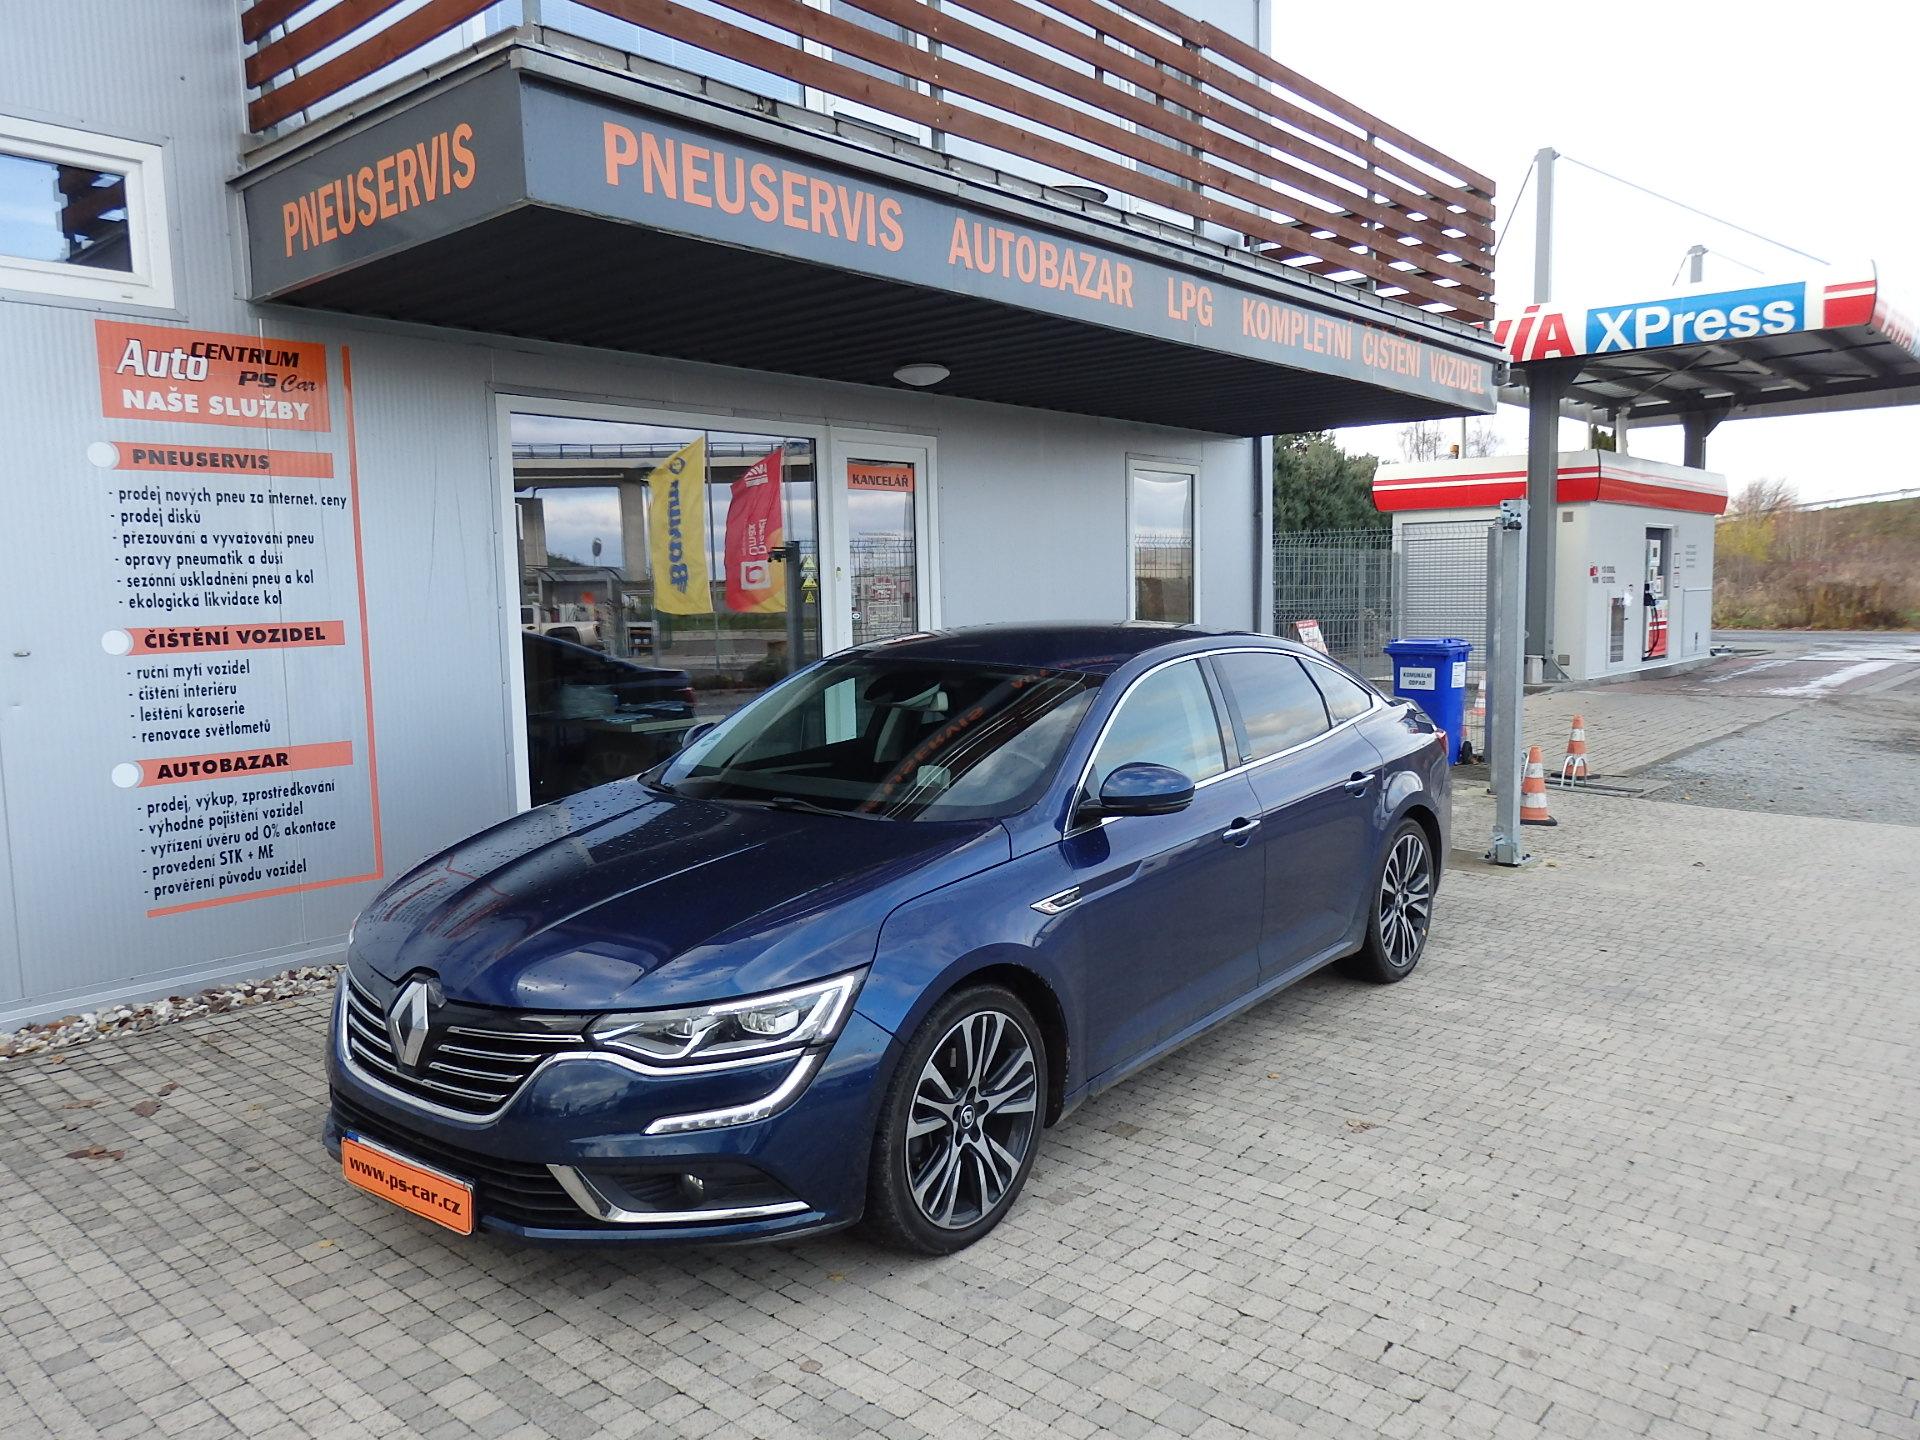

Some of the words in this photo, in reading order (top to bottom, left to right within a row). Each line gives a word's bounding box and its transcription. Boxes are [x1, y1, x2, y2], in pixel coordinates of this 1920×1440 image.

[282, 122, 477, 258] PNEUSERVIS
[602, 122, 904, 252] PNEUSERVIS
[948, 218, 1134, 308] AUTOBAZAR
[1167, 277, 1213, 327] LPG
[1242, 298, 1352, 360] KOMPLETNÍ
[1362, 322, 1421, 378] ČIŠTĚNÍ
[1430, 352, 1484, 394] VOZIDEL
[1595, 300, 1796, 353] XPress
[116, 338, 209, 382] Auto
[191, 342, 300, 368] CENTRUM
[238, 371, 278, 388] PS
[280, 374, 317, 393] Car
[122, 386, 199, 414] NAŠE
[209, 394, 310, 421] SLUŽBY
[132, 448, 270, 470] PNEUSERVIS
[852, 474, 909, 487] KANCELÁŘ
[118, 485, 161, 504] prodej
[165, 487, 211, 505] nových
[216, 492, 245, 506] pneu
[250, 493, 264, 504] za
[269, 489, 317, 505] internet.
[321, 496, 347, 510] ceny
[121, 508, 163, 526] prodej
[168, 508, 201, 523] disků
[123, 531, 195, 549] přezouvání
[200, 535, 208, 545] a
[213, 531, 282, 548] vyvažování
[287, 534, 314, 548] pneu
[125, 555, 171, 569] opravy
[177, 550, 243, 569] pneumatik
[248, 555, 255, 565] a
[260, 550, 283, 565] duší
[127, 572, 175, 587] sezónní
[180, 571, 248, 586] uskladnění
[252, 574, 281, 588] pneu
[285, 574, 292, 584] a
[296, 569, 314, 584] kol
[129, 592, 199, 611] ekologická
[204, 591, 260, 607] likvidace
[264, 589, 282, 605] kol
[144, 626, 229, 648] ČIŠTĚNÍ
[236, 627, 326, 644] VOZIDEL
[137, 664, 168, 679] ruční
[173, 662, 202, 680] mytí
[207, 659, 250, 675] vozidel
[138, 684, 179, 701] čištění
[184, 681, 237, 698] interiéru
[140, 705, 183, 722] leštění
[187, 700, 245, 718] karoserie
[142, 727, 200, 743] renovace
[205, 719, 271, 738] světlometů
[157, 752, 290, 780] AUTOBAZAR
[147, 795, 191, 817] prodej,
[195, 791, 238, 812] výkup,
[242, 781, 336, 806] zprostředkování
[149, 815, 204, 838] výhodné
[208, 807, 259, 830] pojištění
[262, 800, 304, 819] vozidel
[150, 837, 203, 858] vyřízení
[206, 831, 241, 847] úvěru
[245, 826, 259, 841] od
[263, 823, 280, 839] 0%
[284, 820, 336, 836] akontace
[152, 855, 215, 879] provedení
[219, 849, 243, 866] STK
[258, 844, 275, 860] ME
[154, 875, 214, 900] prověření
[219, 866, 262, 889] původu
[266, 858, 307, 878] vozidel
[350, 1157, 461, 1216] www.ps-car.cz
